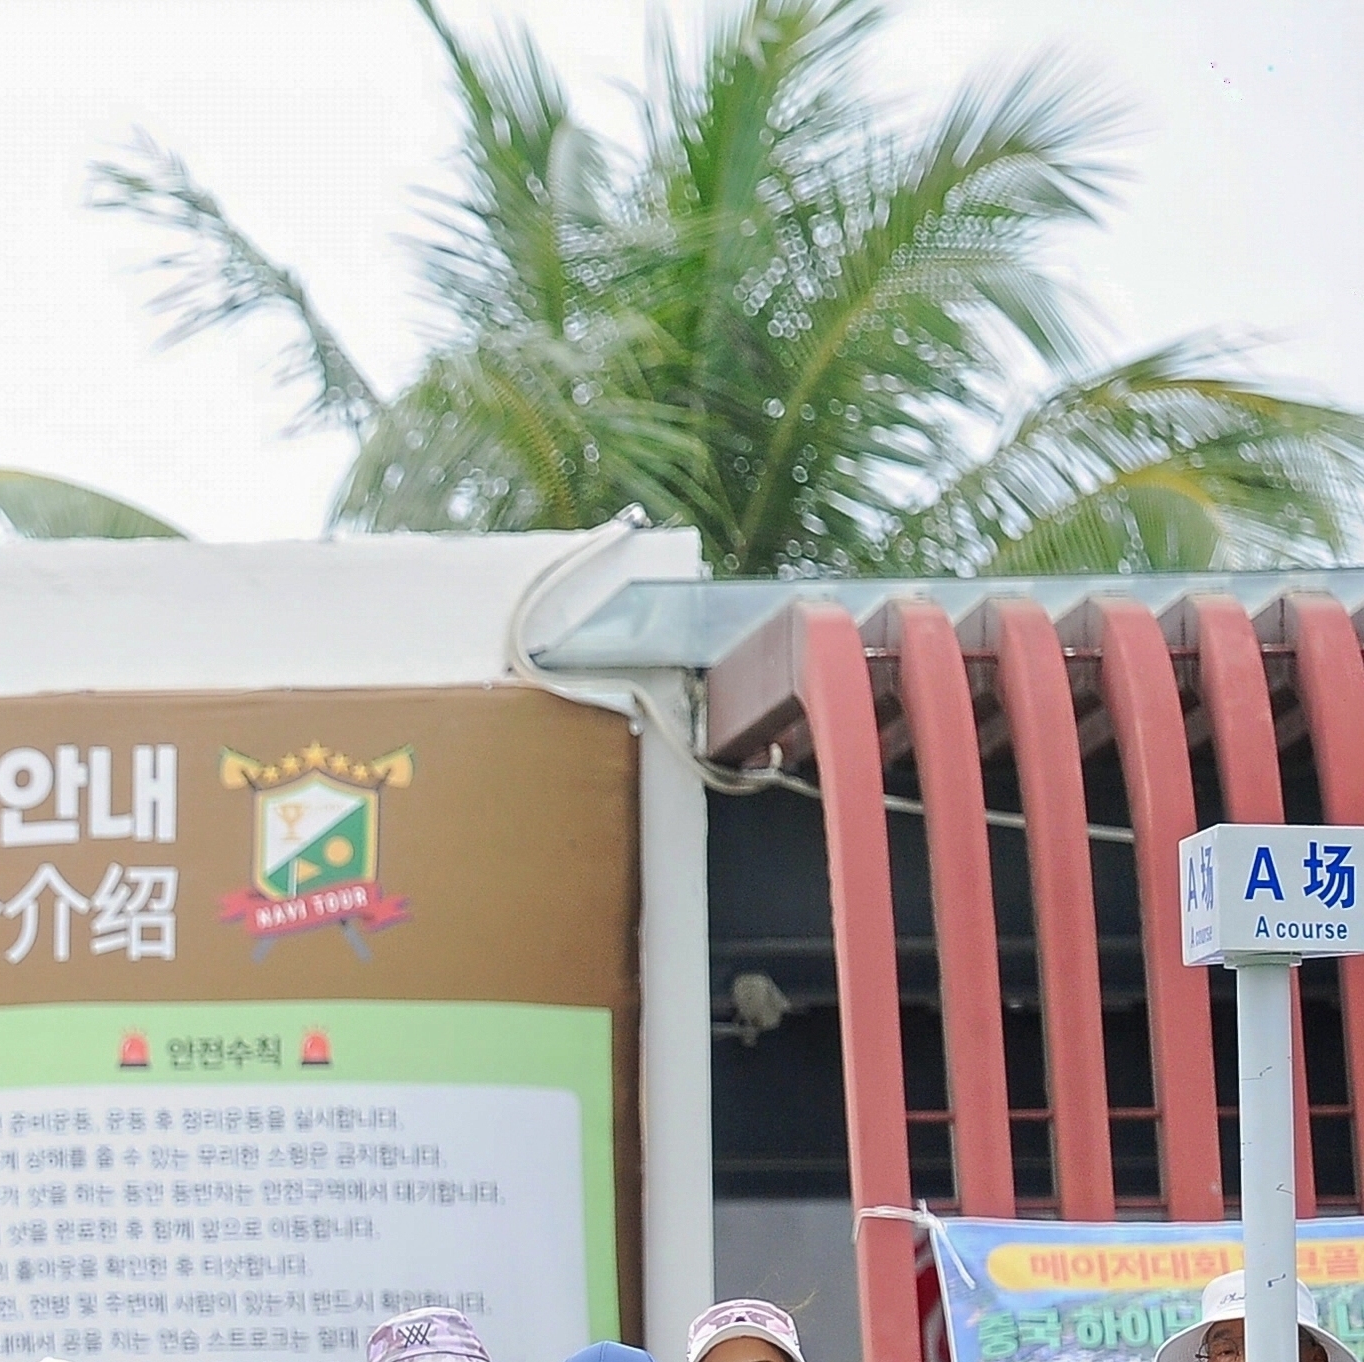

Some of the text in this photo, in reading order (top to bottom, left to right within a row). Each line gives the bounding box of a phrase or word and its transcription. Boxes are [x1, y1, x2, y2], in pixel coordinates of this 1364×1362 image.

[1187, 845, 1215, 912] A 场
[1244, 841, 1355, 909] A 场
[255, 886, 368, 929] NAVI TOUR
[1255, 916, 1348, 940] A course
[166, 1035, 282, 1070] 안전수칙
[1030, 1248, 1230, 1287] 메이저대회
[980, 1308, 1062, 1360] 중국
